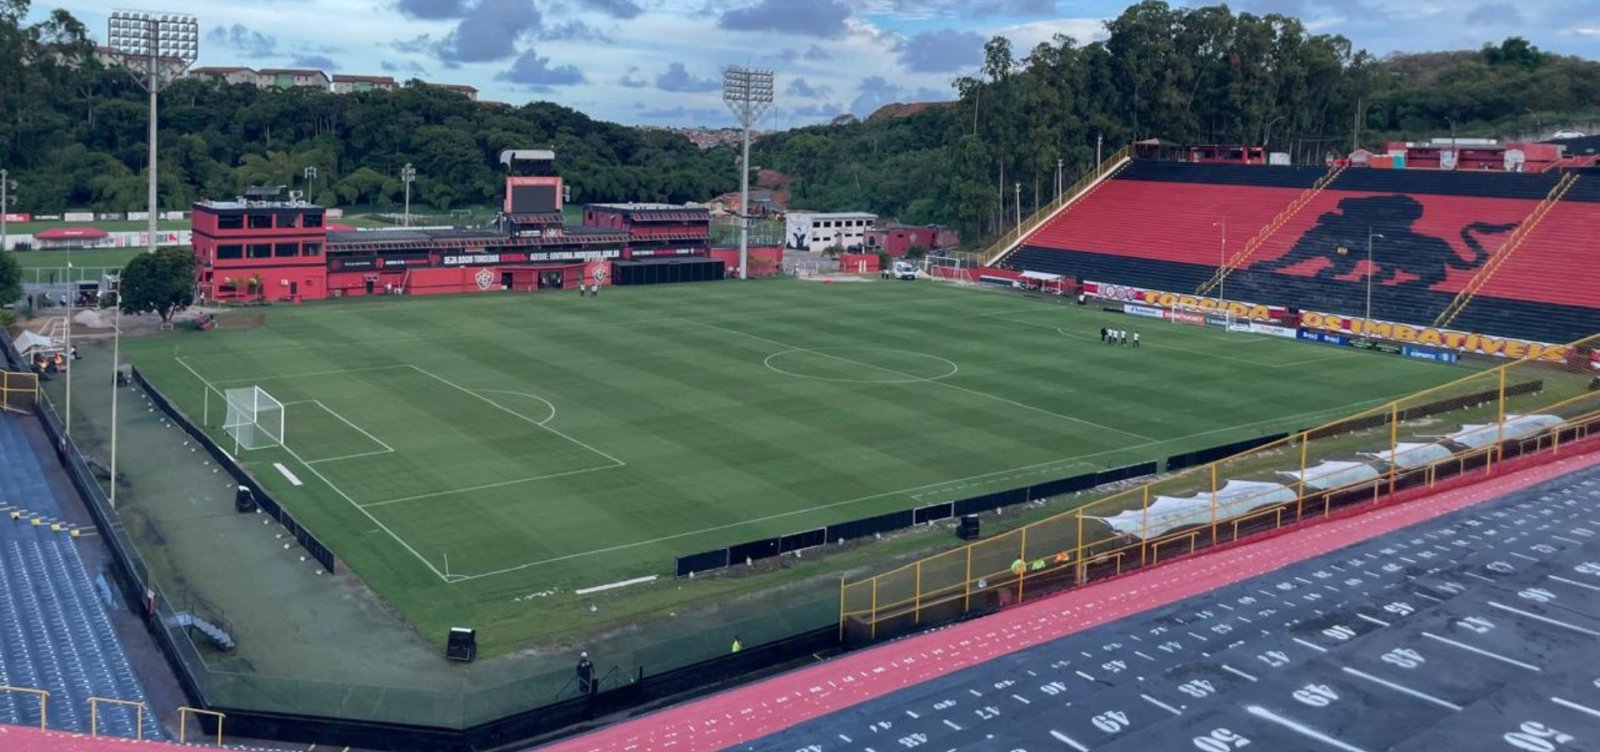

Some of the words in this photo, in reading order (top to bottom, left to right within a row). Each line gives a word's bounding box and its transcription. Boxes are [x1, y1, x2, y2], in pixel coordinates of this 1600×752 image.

[1144, 290, 1270, 321] TORCIDA
[1303, 311, 1343, 332] OS
[1518, 588, 1556, 602] 46
[1384, 602, 1414, 615] 45
[1322, 625, 1355, 640] 46
[1457, 617, 1495, 633] 47
[1258, 651, 1289, 667] 47
[1381, 648, 1424, 668] 48
[1179, 680, 1215, 697] 48
[1293, 684, 1338, 706] 49
[976, 707, 999, 719] 47
[1092, 711, 1129, 732] 49
